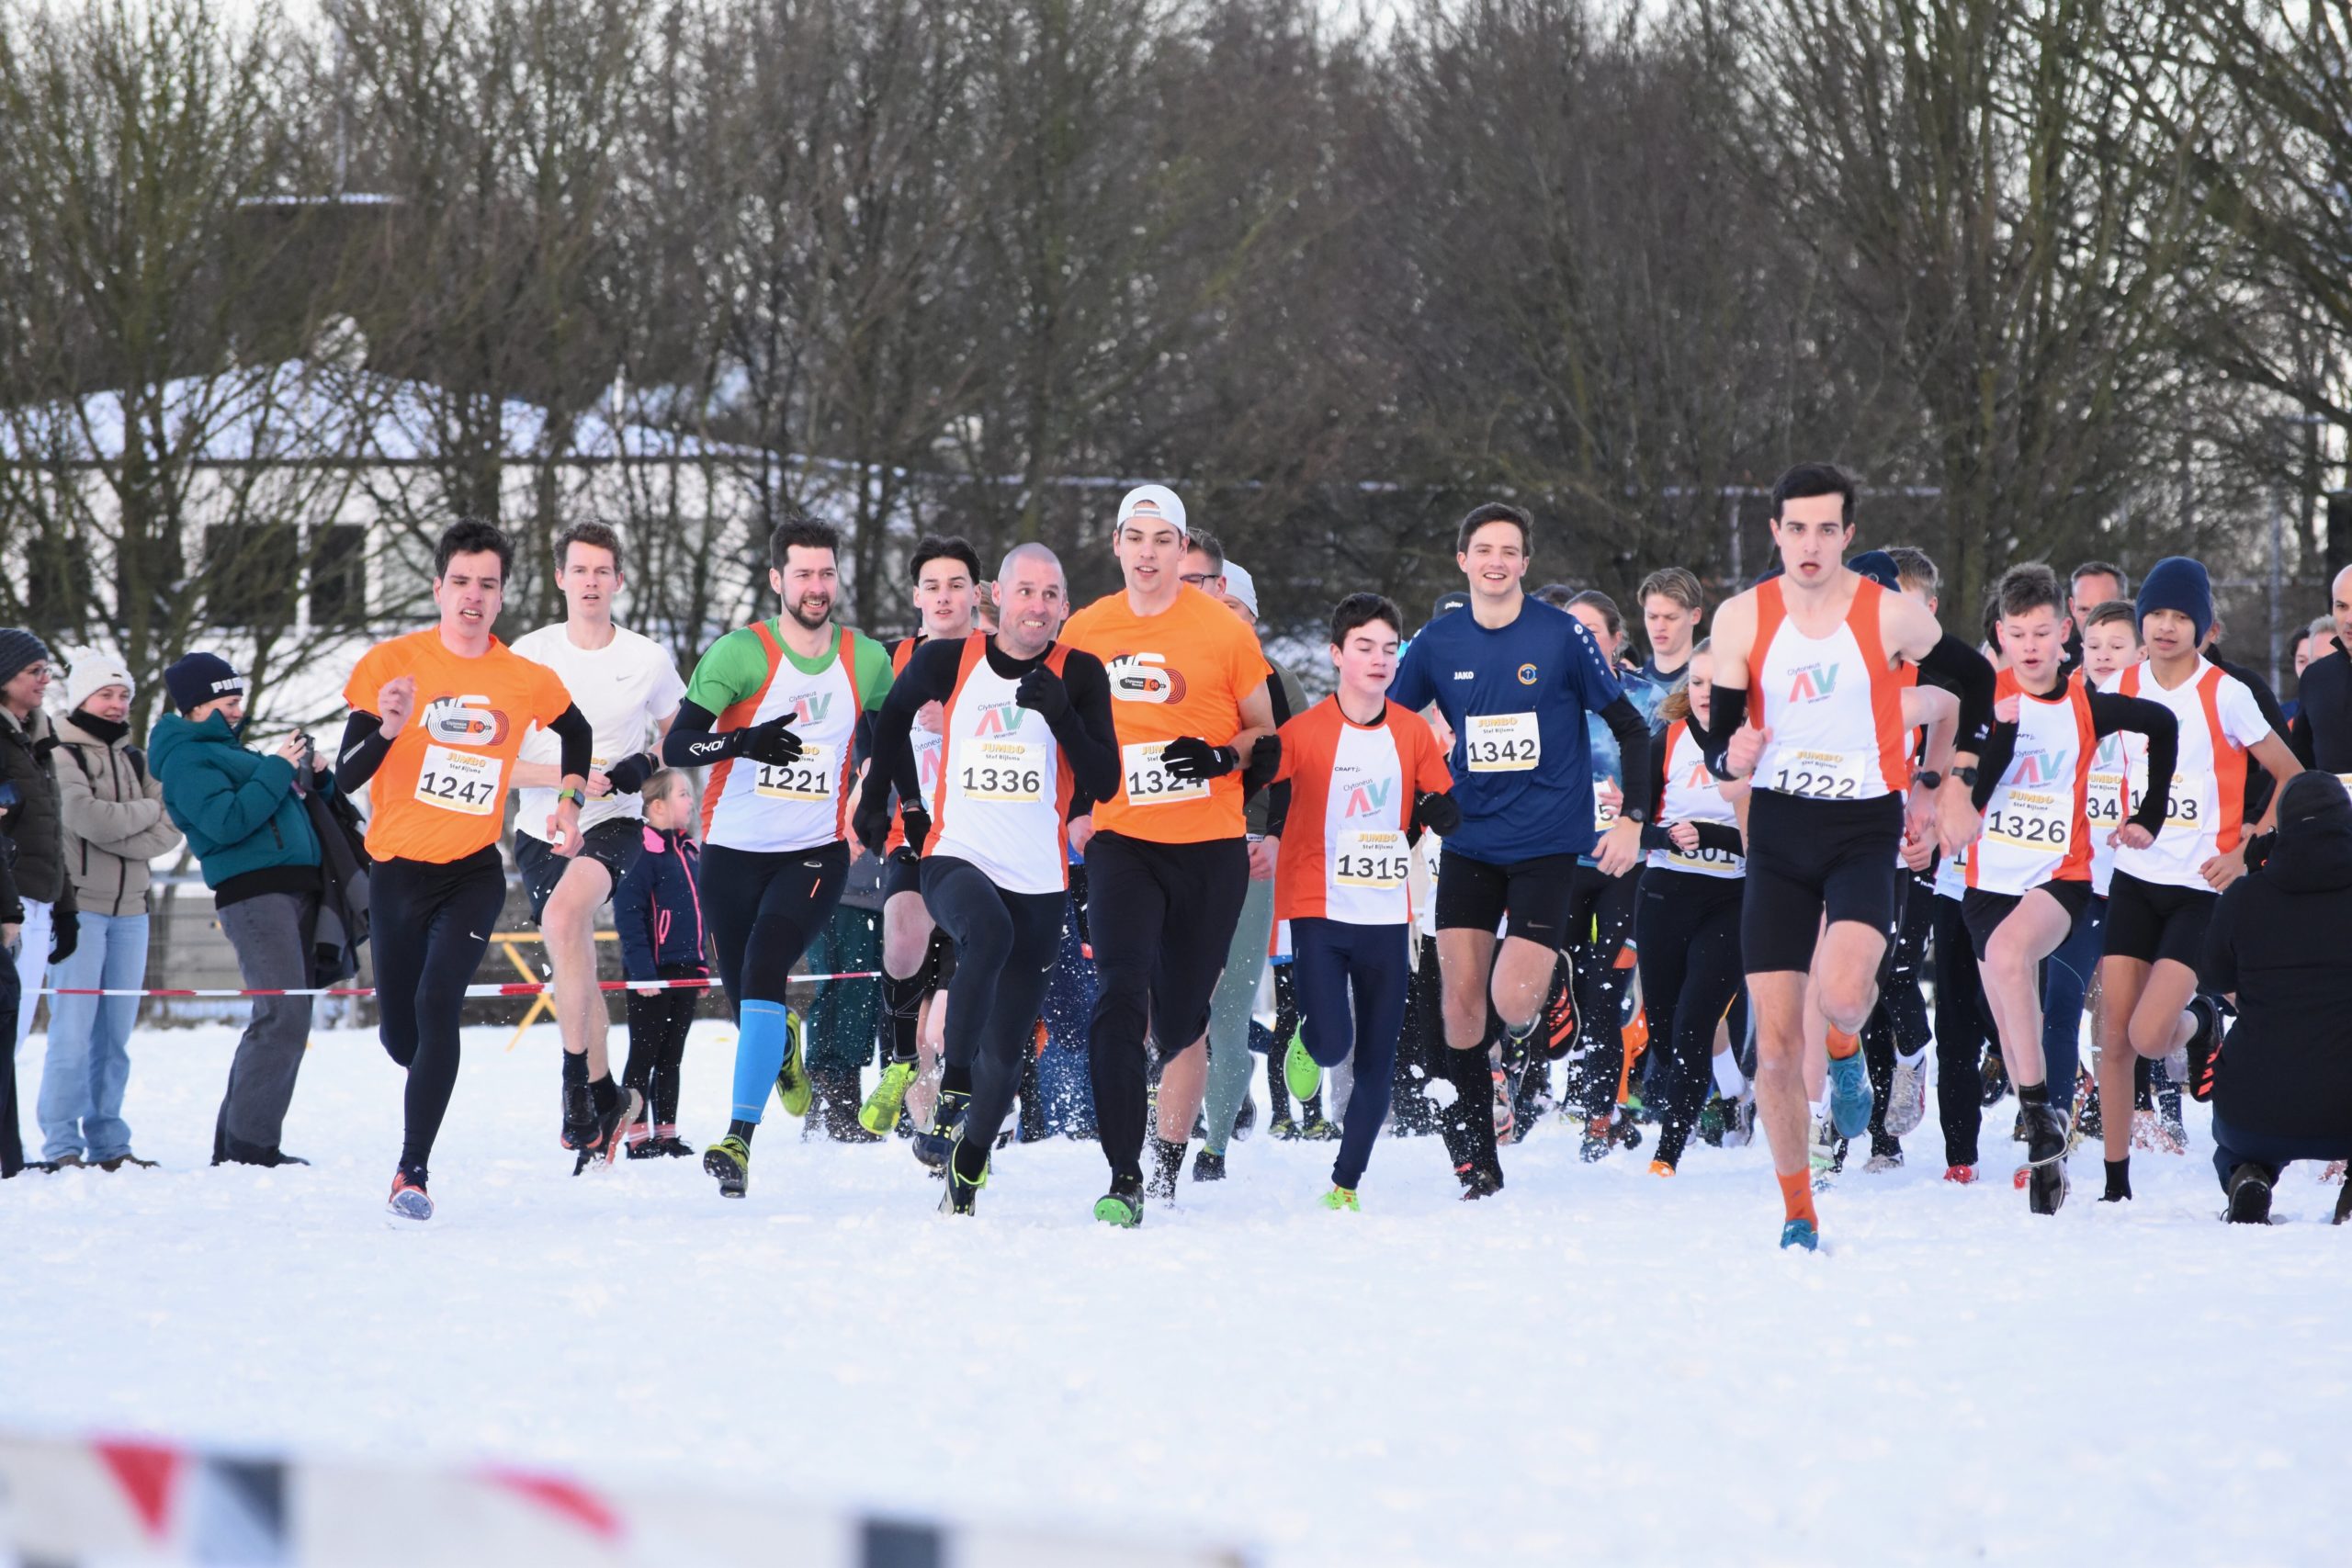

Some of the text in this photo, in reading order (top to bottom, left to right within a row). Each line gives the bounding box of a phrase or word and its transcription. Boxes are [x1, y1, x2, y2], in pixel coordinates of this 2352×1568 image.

[1453, 671, 1475, 681] JAKO
[1787, 662, 1821, 676] Clytoneus
[1789, 663, 1839, 703] AV
[788, 691, 817, 703] Clytoneus
[978, 701, 1011, 712] Clytoneus
[975, 706, 1026, 737] AV
[1478, 717, 1518, 728] JUMBO
[981, 743, 1025, 754] JUMBO
[1468, 739, 1537, 762] 1342
[1797, 750, 1843, 763] JUMBO
[447, 752, 486, 768] JUMBO
[2012, 750, 2067, 784] AV
[420, 772, 494, 805] 1247
[758, 765, 830, 795] 1221
[963, 767, 1040, 793] 1336
[1343, 778, 1374, 792] Clytoneus
[1774, 769, 1856, 799] 1222
[1344, 777, 1392, 819] AV
[2009, 790, 2054, 804] JUMBO
[1989, 810, 2066, 844] 1326
[1359, 833, 1398, 842] JUMBO
[1338, 854, 1408, 879] 1315
